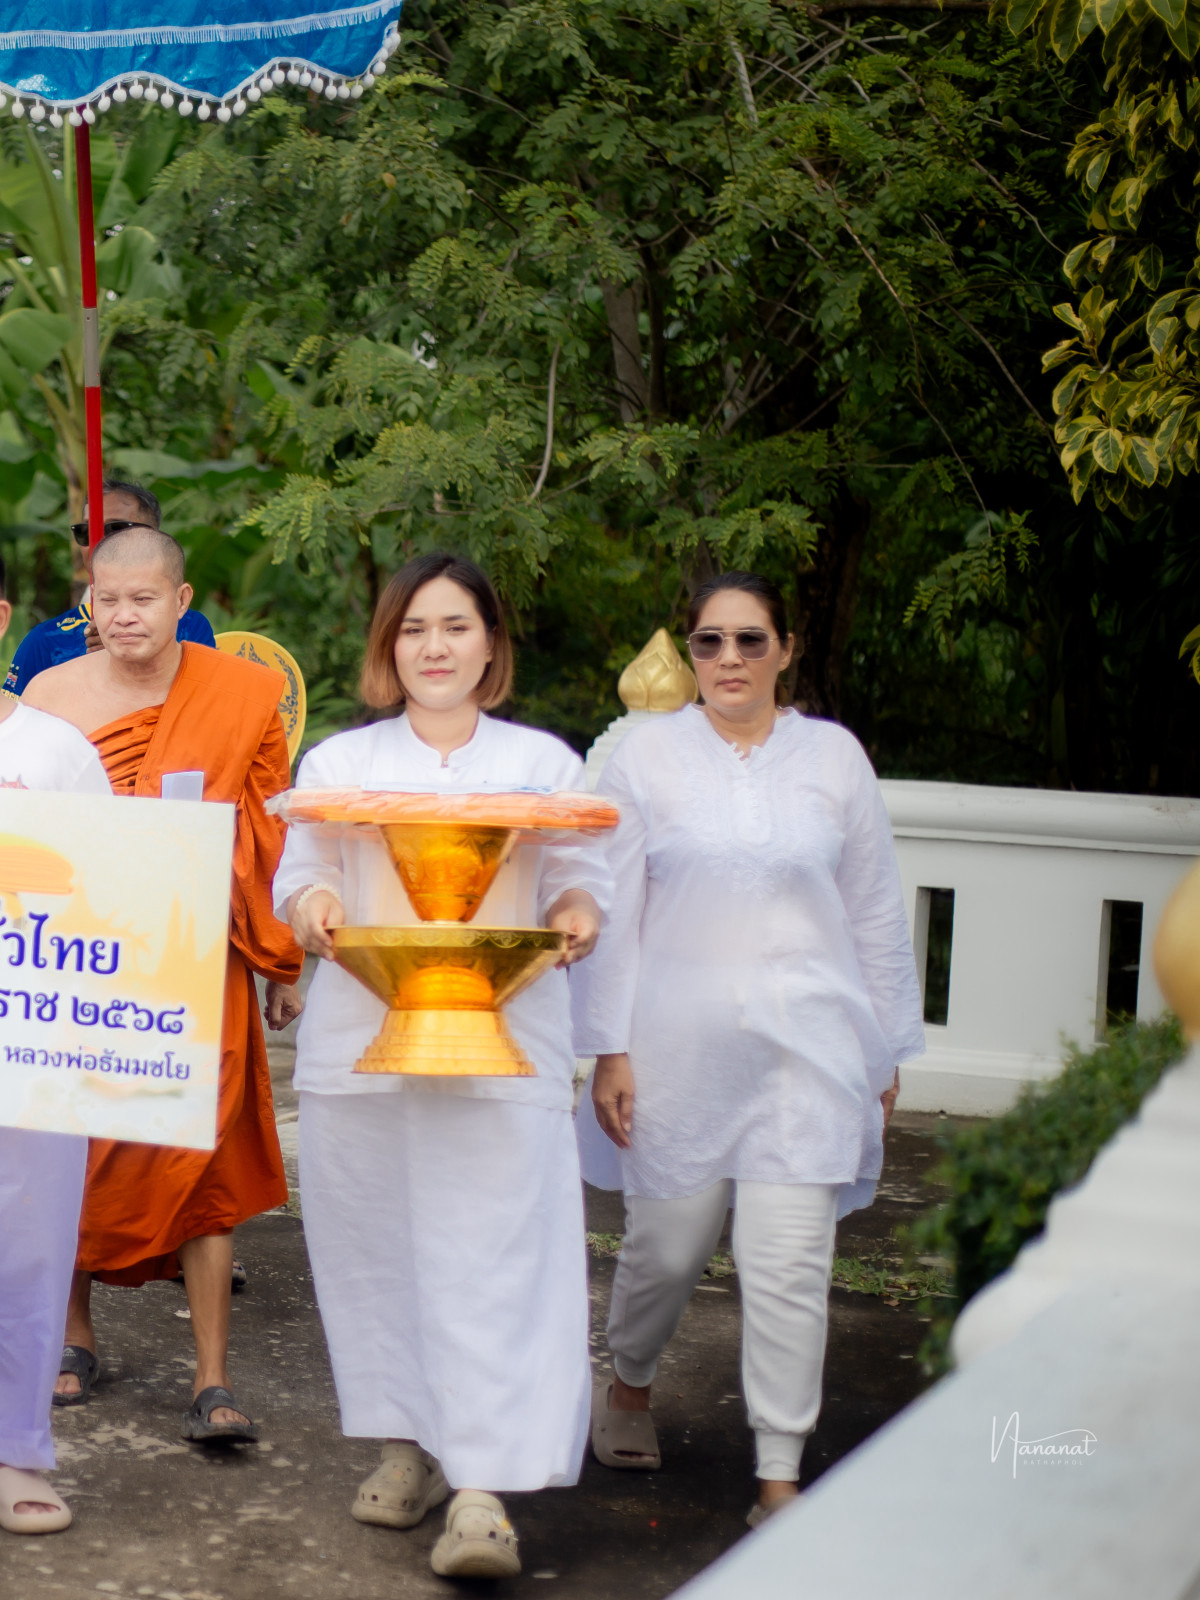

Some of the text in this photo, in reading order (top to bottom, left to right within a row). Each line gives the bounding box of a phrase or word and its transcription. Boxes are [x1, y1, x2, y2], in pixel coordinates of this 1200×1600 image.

[71, 994, 187, 1036] ๒๕๖๘
[4, 1045, 191, 1082] หลวงพ่อธัมมชโย
